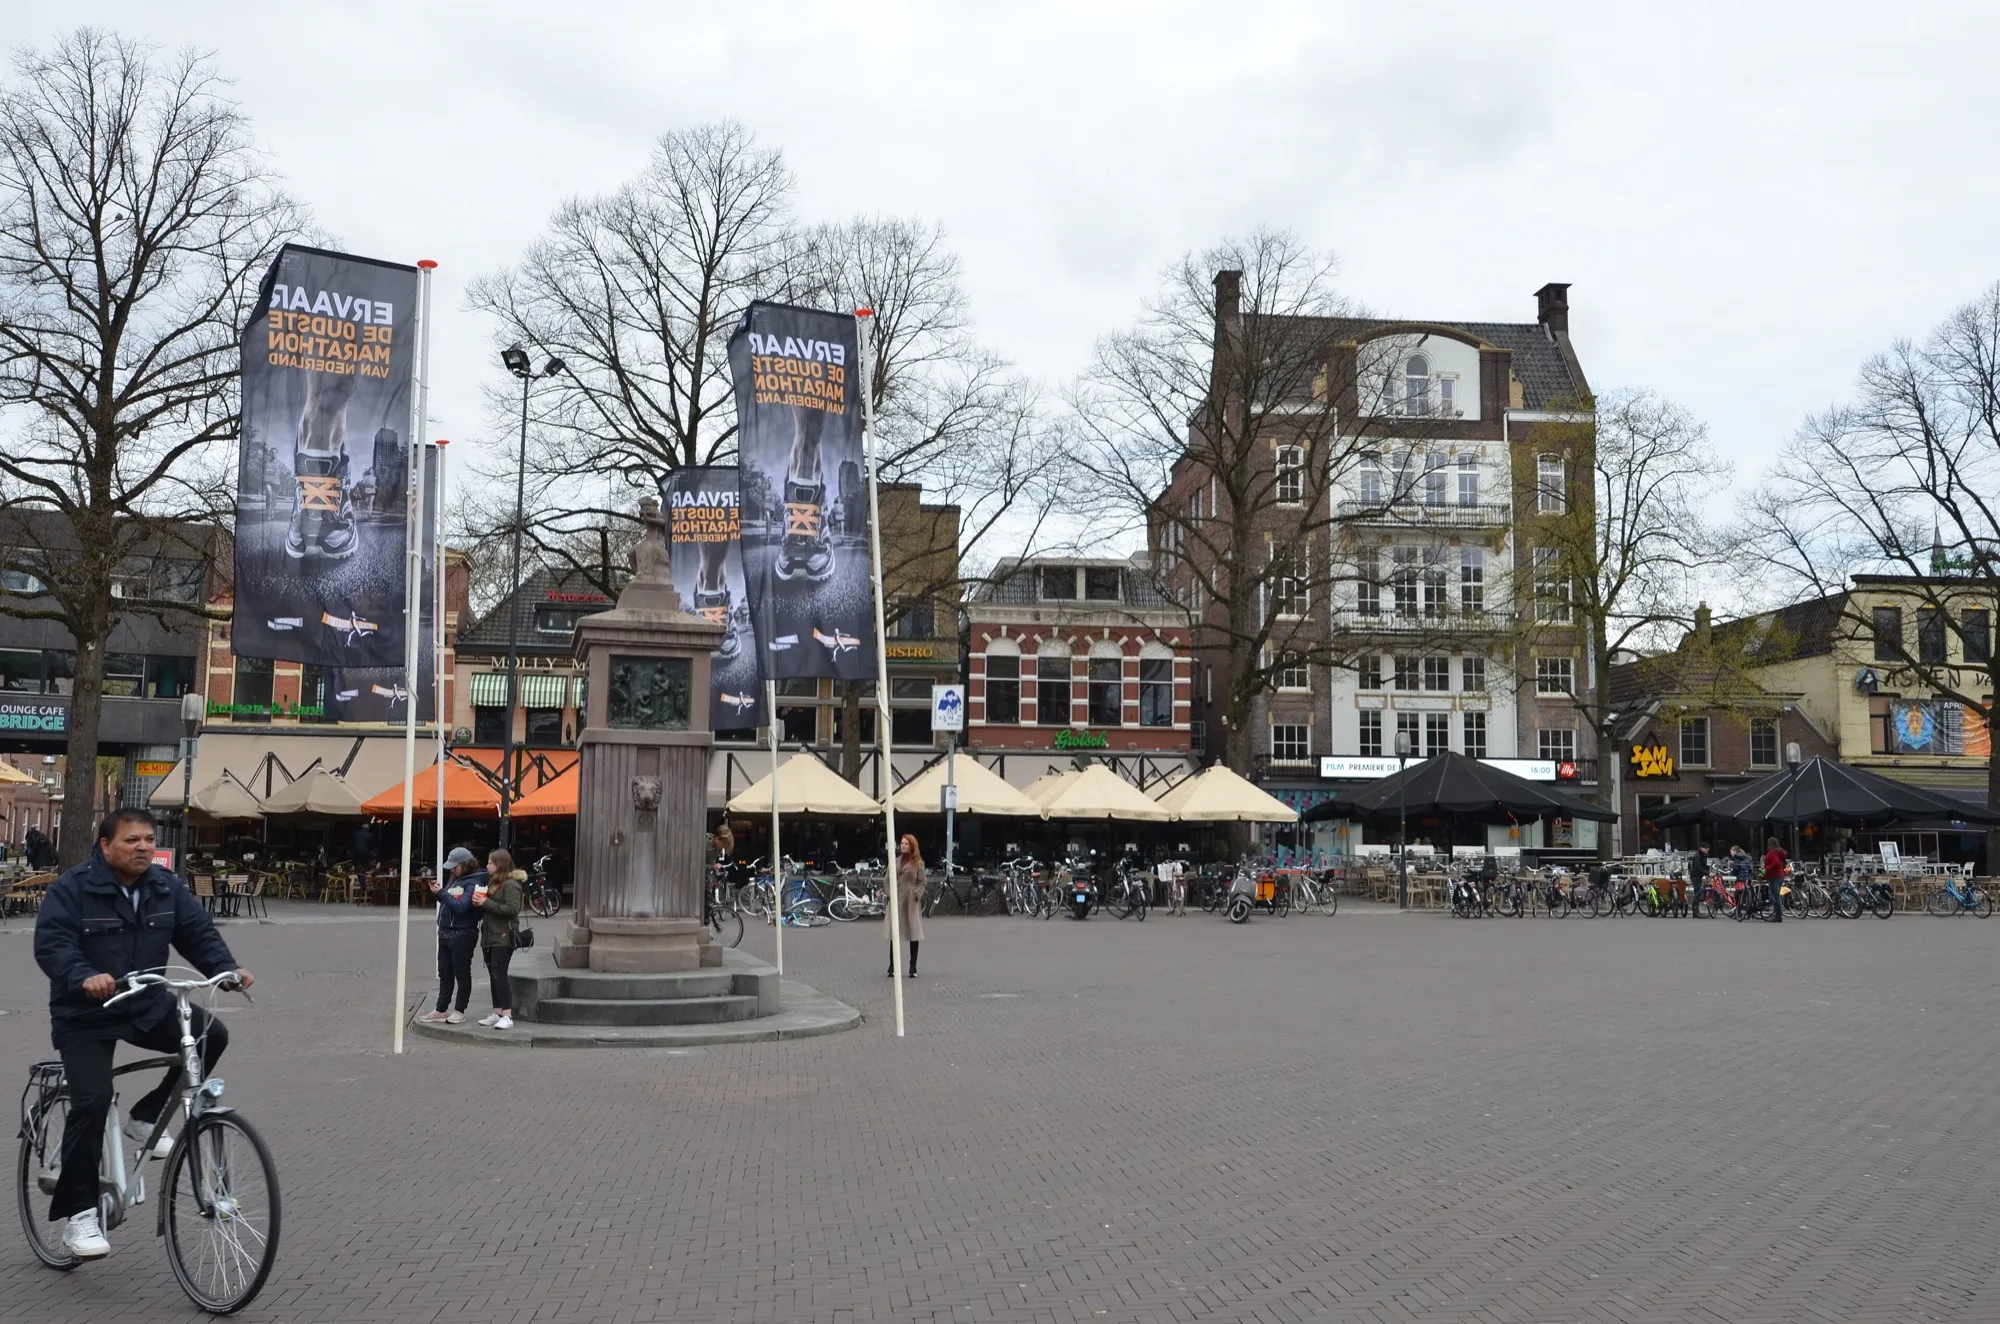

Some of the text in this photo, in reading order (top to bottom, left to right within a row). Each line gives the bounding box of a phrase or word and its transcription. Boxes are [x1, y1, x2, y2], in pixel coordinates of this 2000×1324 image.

[885, 646, 933, 657] BISTRO
[0, 704, 65, 716] OUNGE CAFE
[0, 713, 65, 731] BRIDGE
[1056, 728, 1108, 750] Grolsch
[1631, 745, 1667, 763] SAM
[1326, 763, 1345, 771] FILM
[1348, 763, 1385, 772] PREMIERE
[1387, 764, 1396, 772] DE
[1530, 766, 1551, 774] 16:00
[1561, 765, 1574, 777] illy
[1637, 757, 1673, 777] SAM
